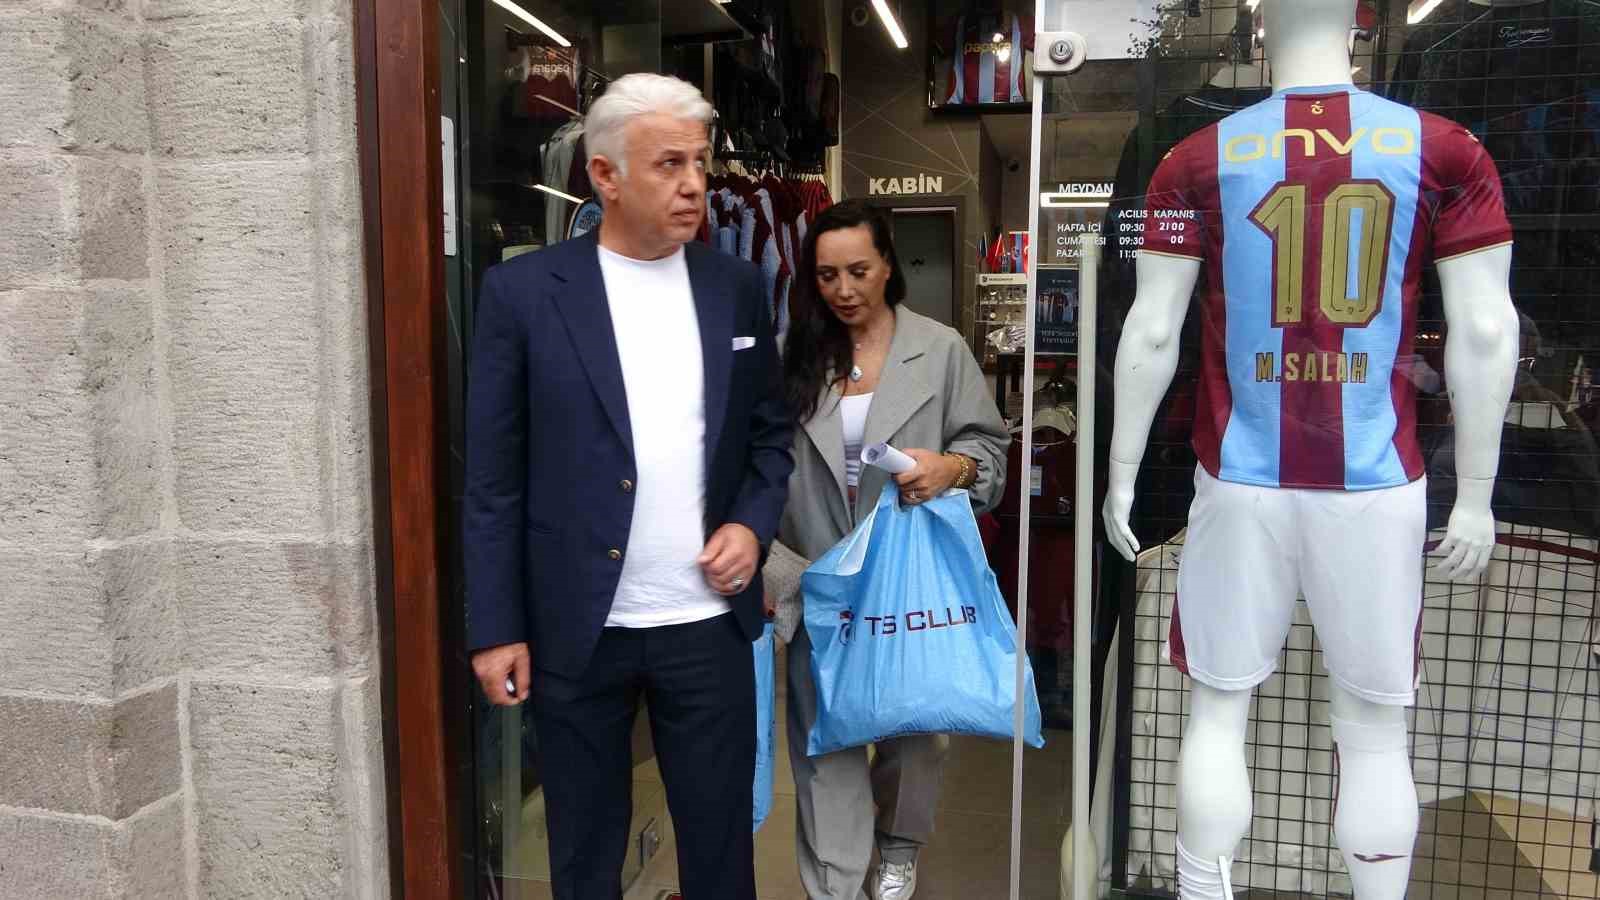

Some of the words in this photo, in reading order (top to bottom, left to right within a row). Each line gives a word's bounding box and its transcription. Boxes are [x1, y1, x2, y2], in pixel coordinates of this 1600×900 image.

[1224, 127, 1416, 163] onvo
[869, 172, 943, 195] KABİN
[1059, 183, 1114, 194] MEYDAN
[1057, 223, 1086, 232] HAFTA
[1119, 223, 1145, 232] 09:30
[1119, 236, 1144, 246] 09:30
[1247, 179, 1397, 328] 10
[864, 615, 897, 636] TS
[905, 606, 977, 632] CLUB
